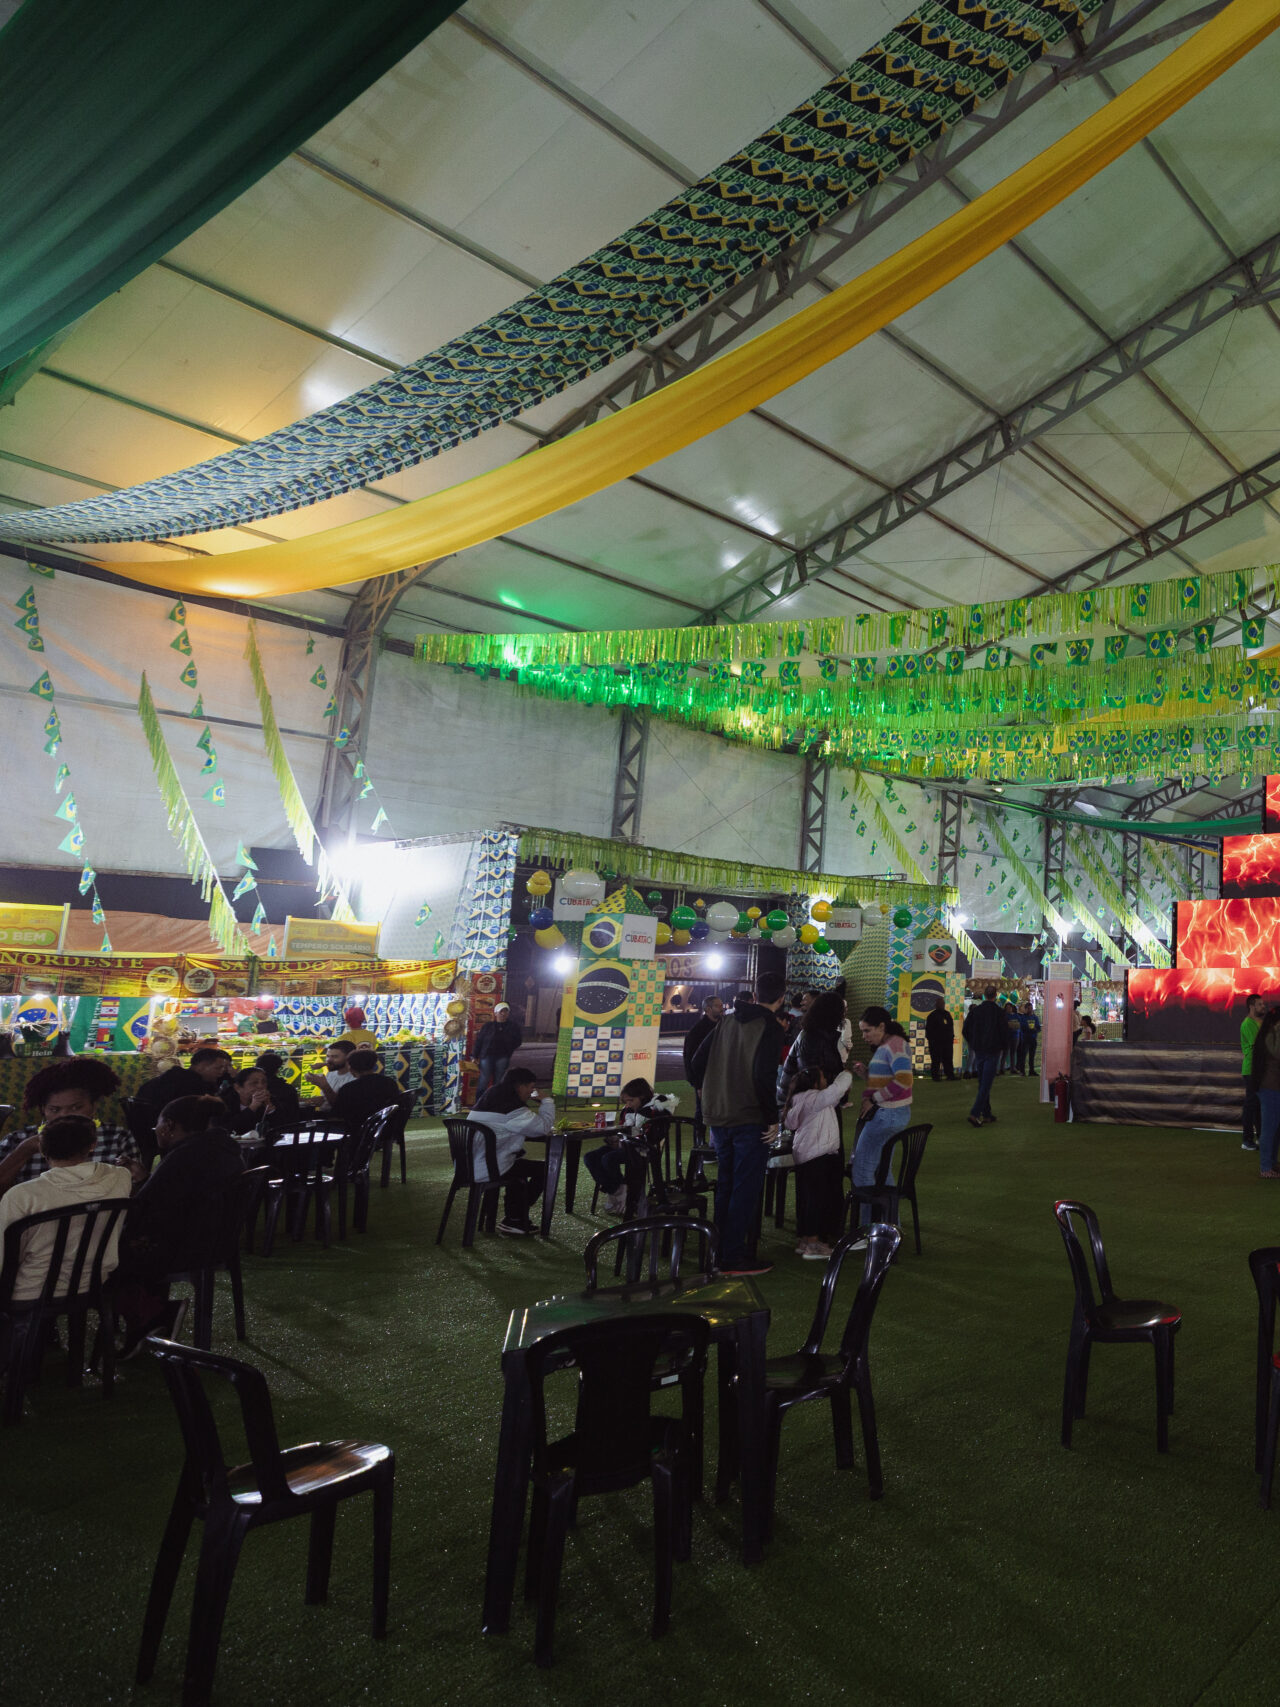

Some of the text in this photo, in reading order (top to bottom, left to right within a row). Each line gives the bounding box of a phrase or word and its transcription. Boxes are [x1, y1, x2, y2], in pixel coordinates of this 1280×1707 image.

[12, 932, 47, 943] BEM
[0, 951, 145, 969] NORDESTE
[220, 961, 430, 972] SAOR DO NORDESTE
